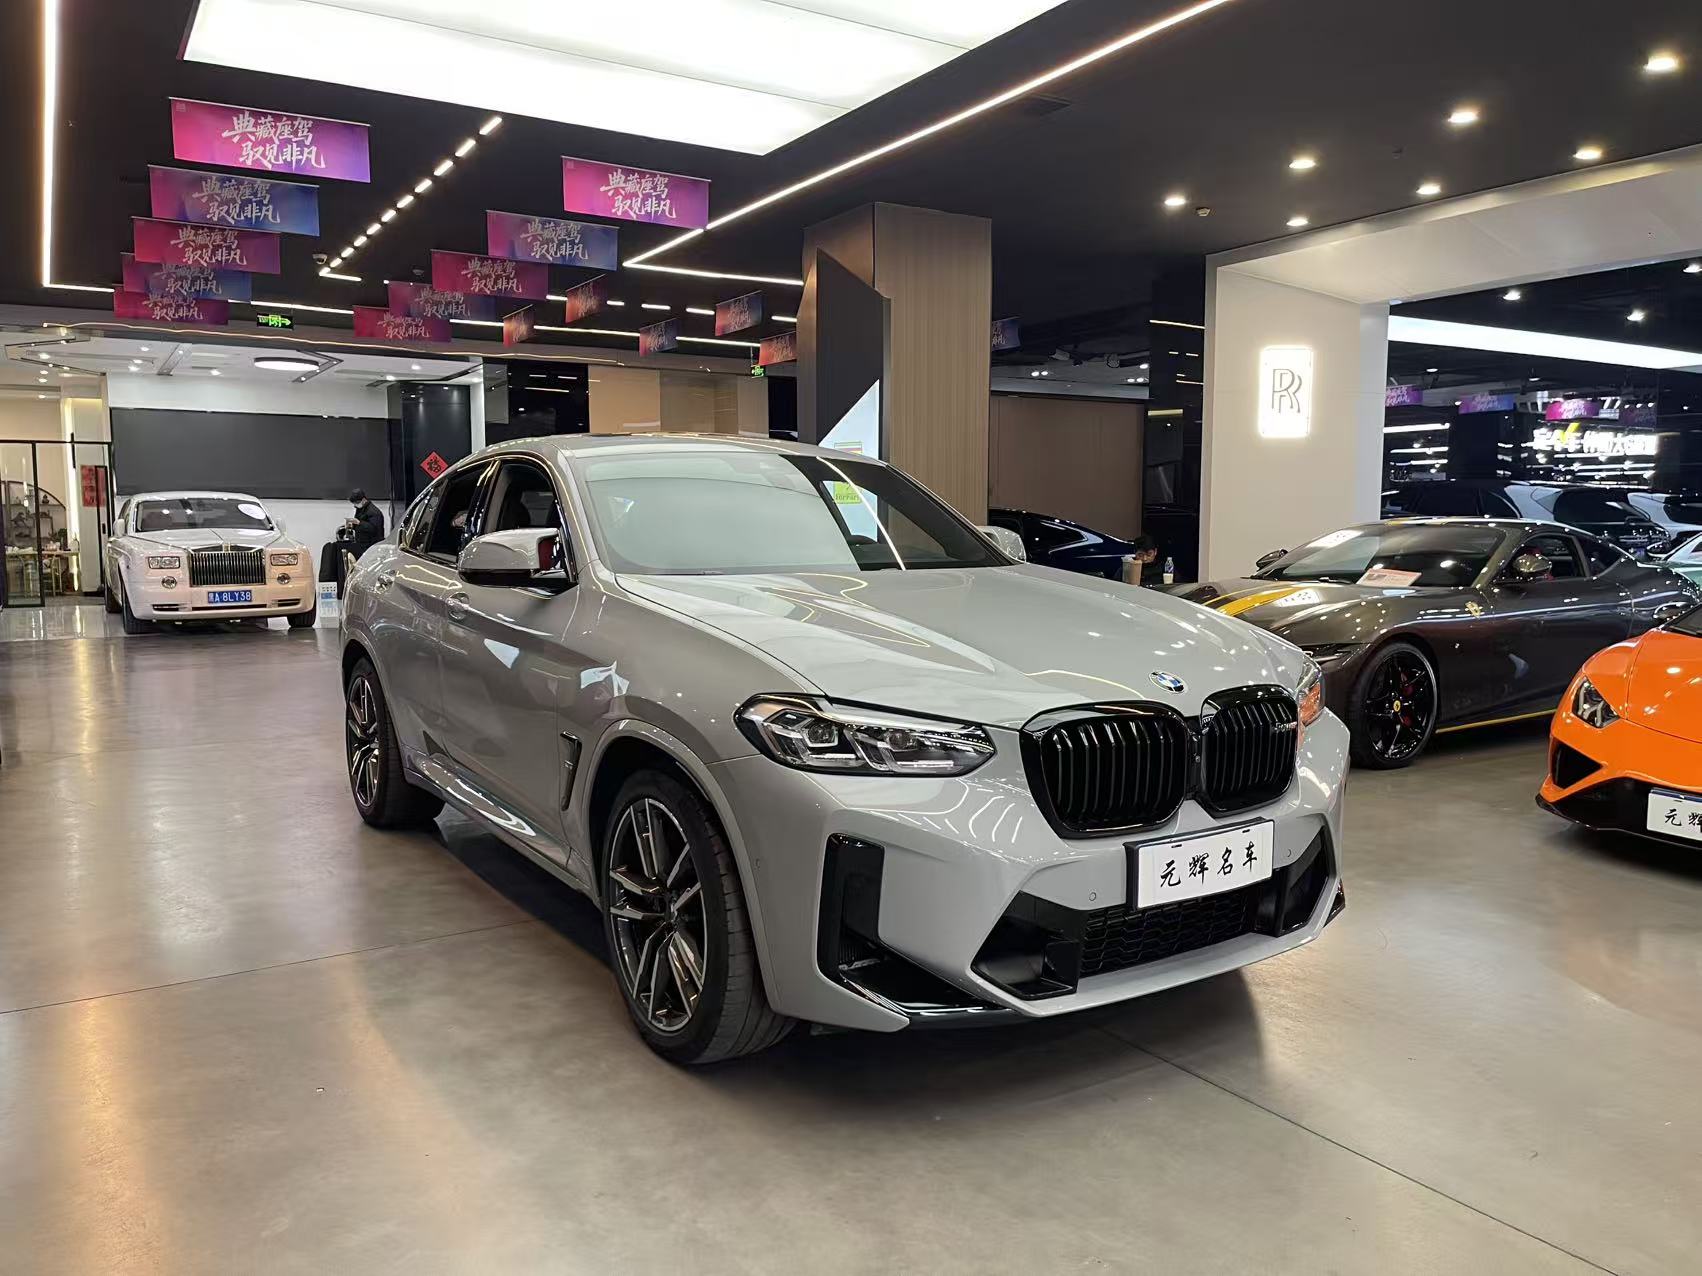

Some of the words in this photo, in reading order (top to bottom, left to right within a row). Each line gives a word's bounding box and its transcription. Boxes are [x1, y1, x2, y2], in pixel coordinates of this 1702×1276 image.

[222, 111, 313, 145] 典藏座驾
[239, 142, 326, 171] 驭见非凡
[192, 177, 271, 204] 典藏座驾
[600, 169, 668, 198] 典藏座驾
[206, 202, 281, 225] 驭见非凡
[612, 195, 676, 220] 驭见非凡
[170, 225, 238, 248] 典藏座驾
[520, 218, 581, 243] 典藏座驾
[183, 247, 247, 266] 驭见非凡
[531, 241, 588, 262] 驭见非凡
[461, 257, 516, 278] 典藏座驾
[470, 277, 521, 295] 驭见非凡
[1160, 841, 1257, 888] 元辉名车
